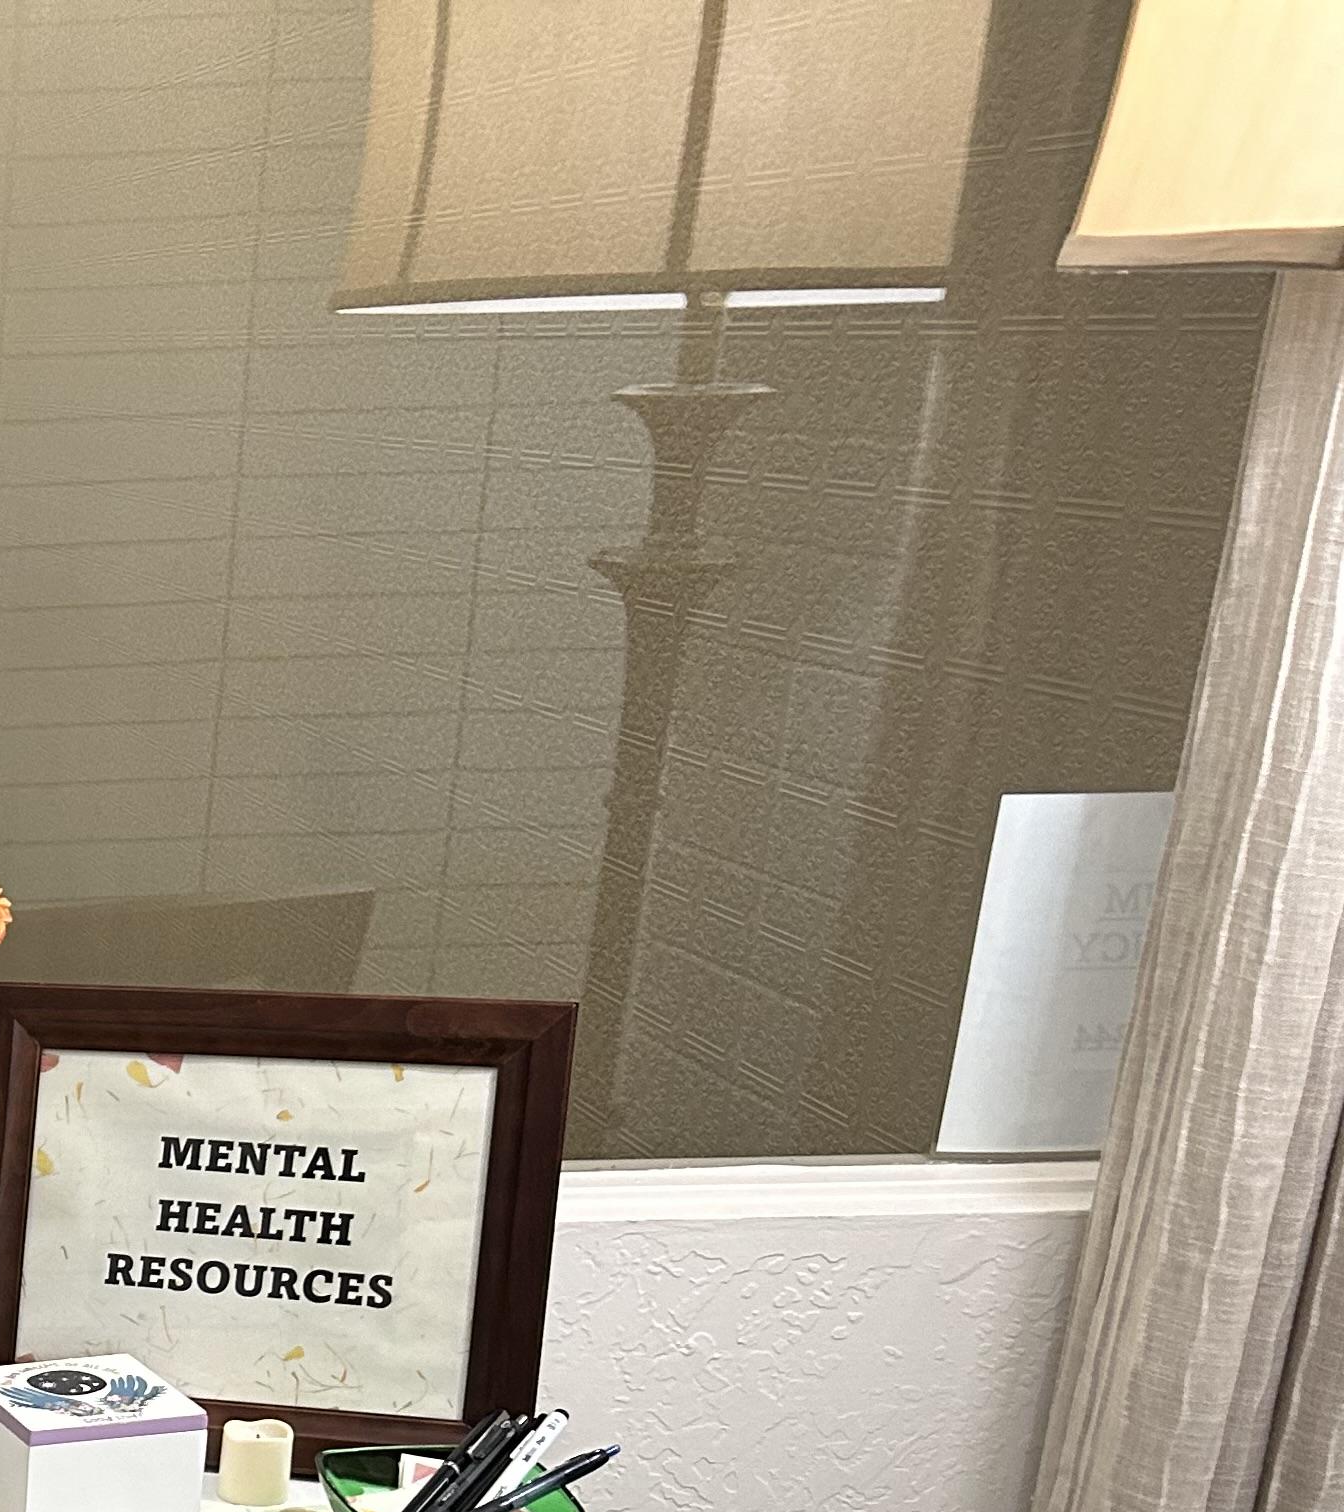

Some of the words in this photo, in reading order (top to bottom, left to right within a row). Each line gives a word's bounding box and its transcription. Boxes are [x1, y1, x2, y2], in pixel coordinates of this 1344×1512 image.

[157, 1135, 367, 1184] MENTAL
[154, 1198, 355, 1247] HEALTH
[102, 1251, 394, 1310] RESOURCES
